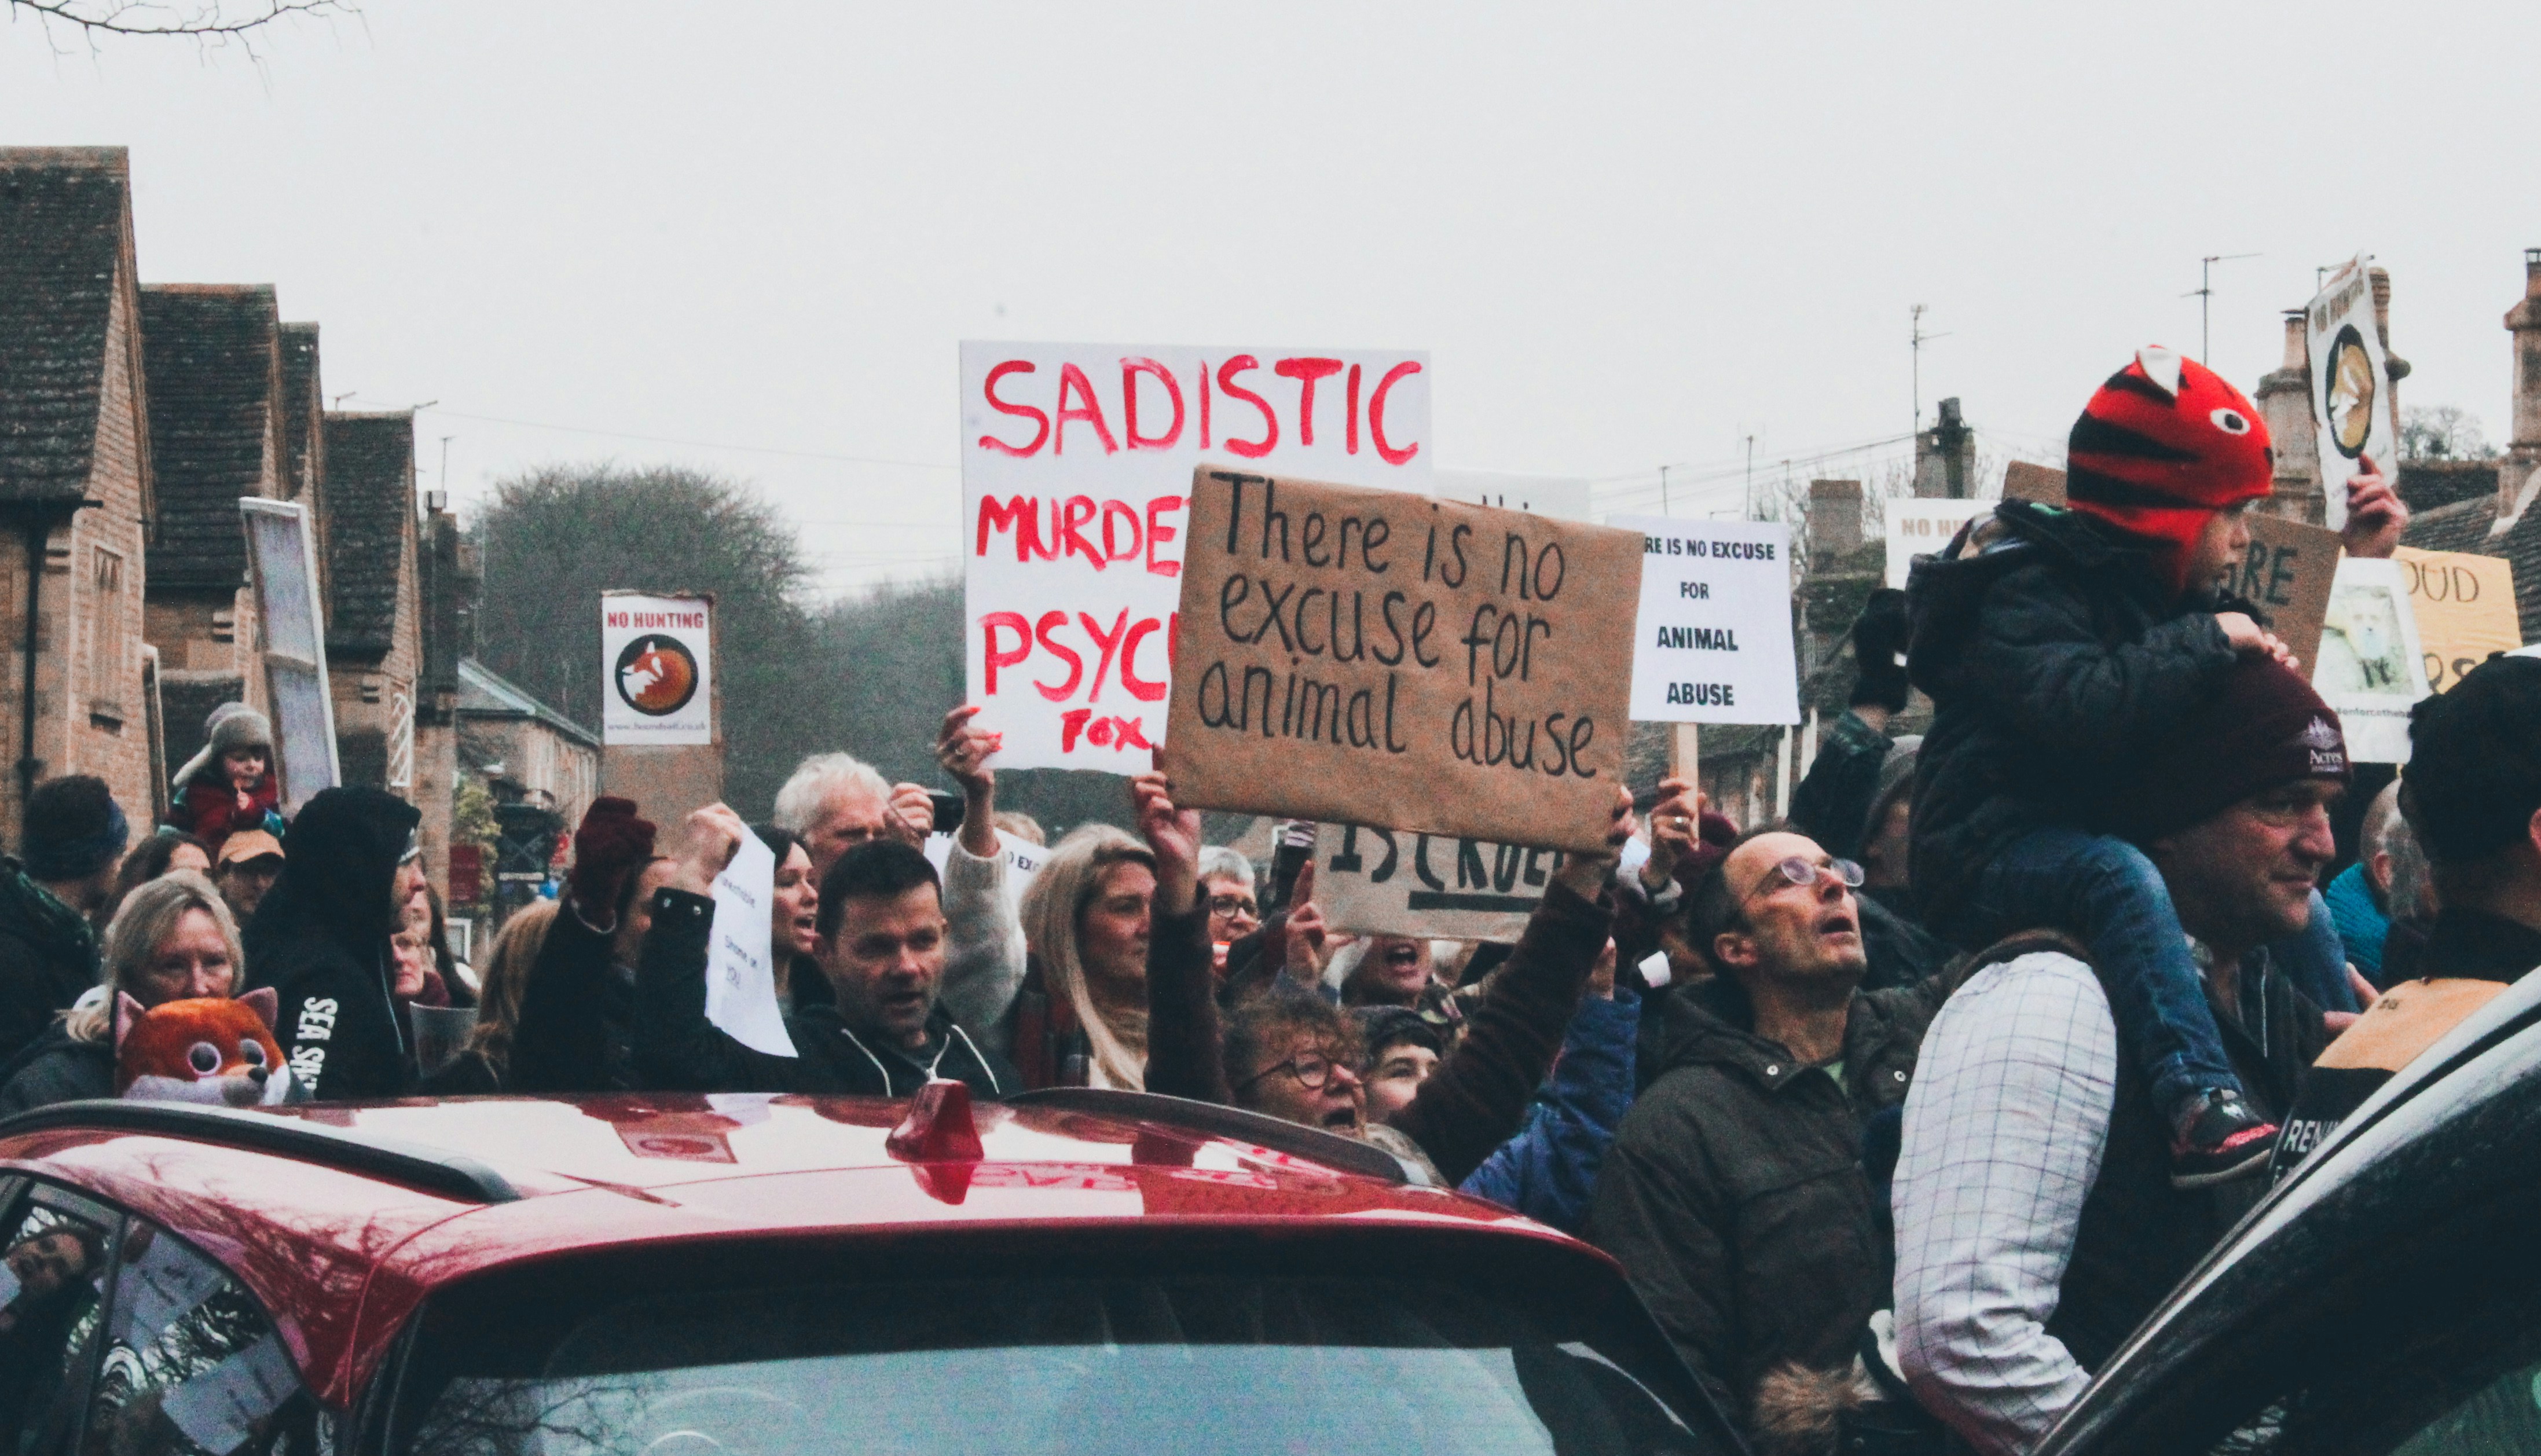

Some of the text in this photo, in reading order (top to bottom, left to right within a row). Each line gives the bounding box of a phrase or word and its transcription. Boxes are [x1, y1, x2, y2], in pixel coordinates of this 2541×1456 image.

[978, 354, 1422, 465] SADISTIC
[976, 494, 1191, 577] MURDE
[1211, 471, 1565, 602] There is no
[1645, 536, 1775, 560] RE IS NO EXCUSE
[1901, 518, 1930, 537] NO
[1680, 581, 1709, 599] FOR
[608, 612, 705, 629] NO HUNTING
[1221, 572, 1551, 687] excuse for
[1657, 626, 1739, 651] ANIMAL
[977, 606, 1179, 702] PSYC
[1666, 682, 1735, 706] ABUSE
[1198, 656, 1598, 777] animal abuse
[296, 996, 338, 1040] SEA
